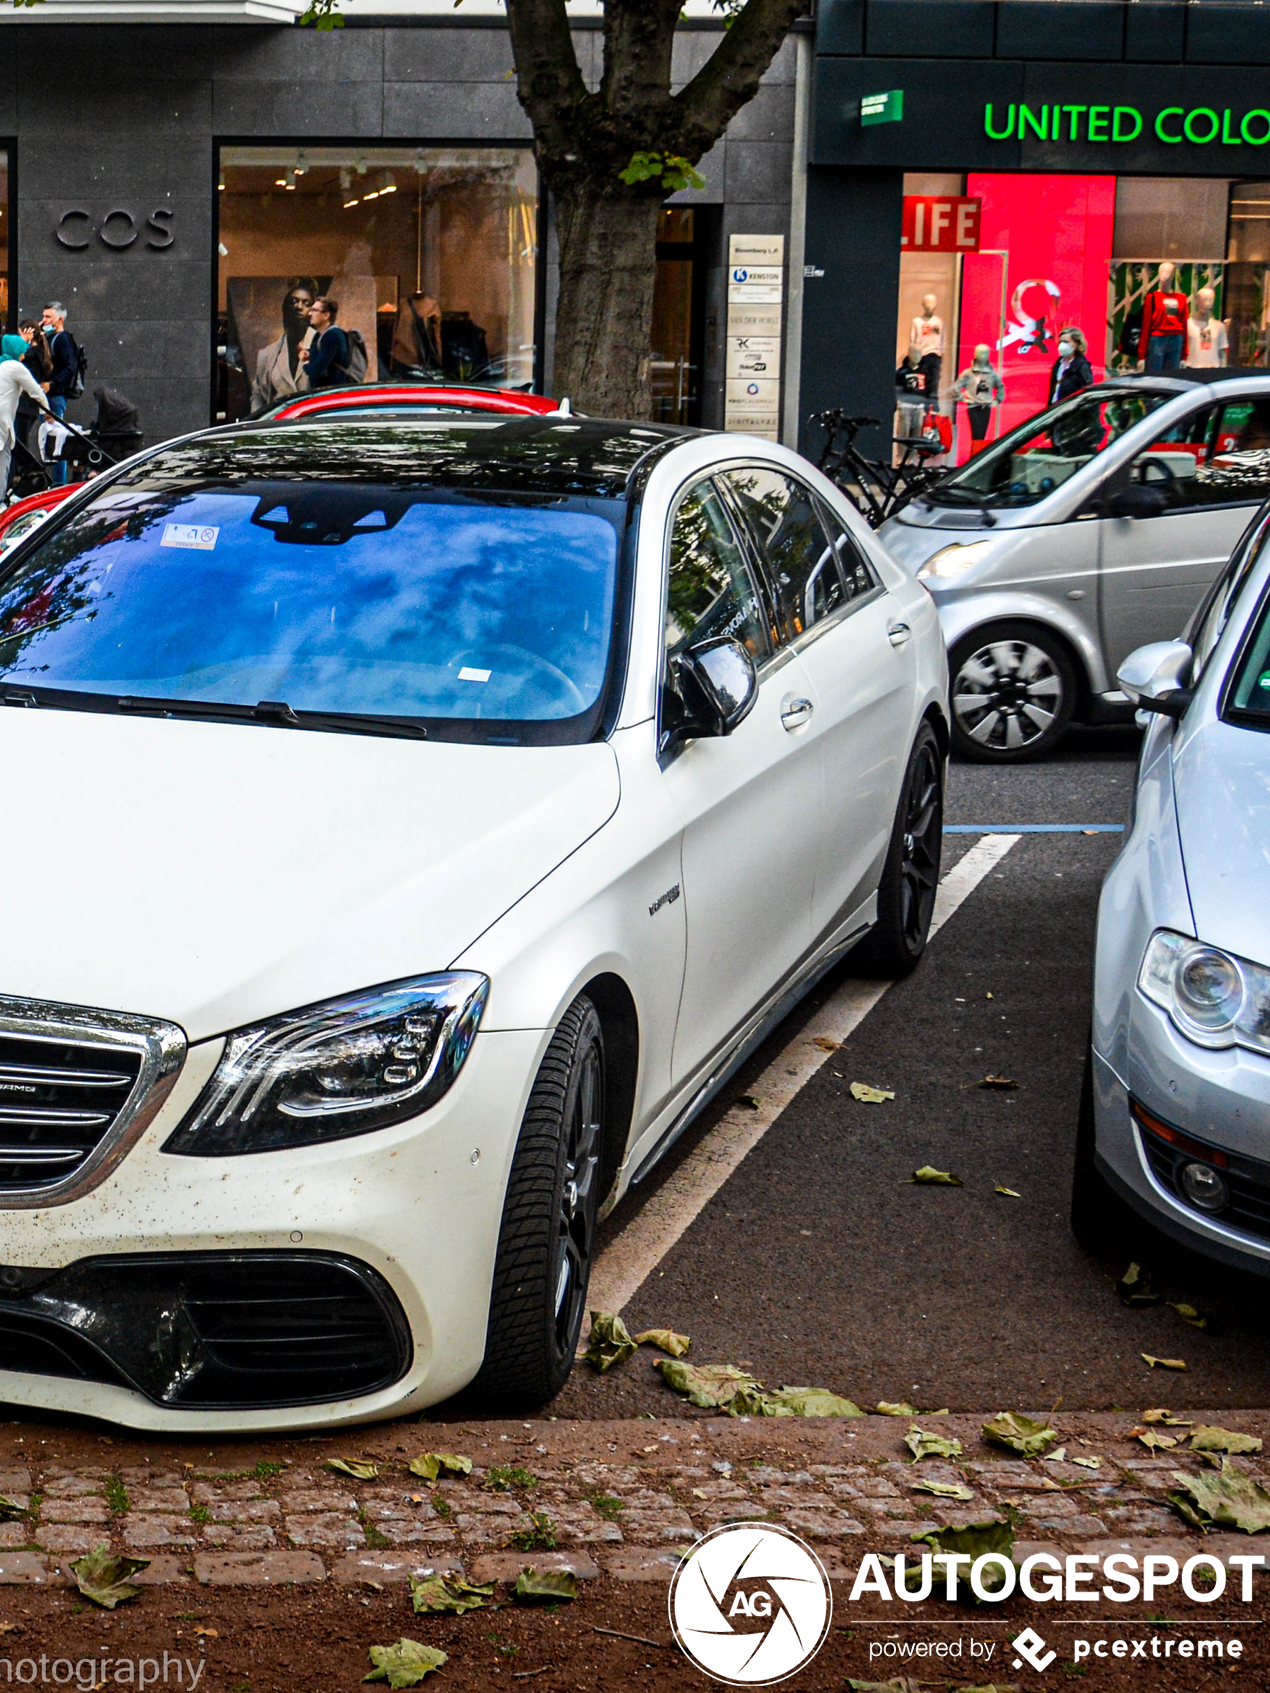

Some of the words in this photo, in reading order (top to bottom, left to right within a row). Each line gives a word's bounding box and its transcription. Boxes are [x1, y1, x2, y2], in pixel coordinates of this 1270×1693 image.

[984, 103, 1143, 141] UNITED
[1154, 107, 1270, 145] COLO
[56, 209, 175, 248] COS
[901, 203, 977, 246] IFE
